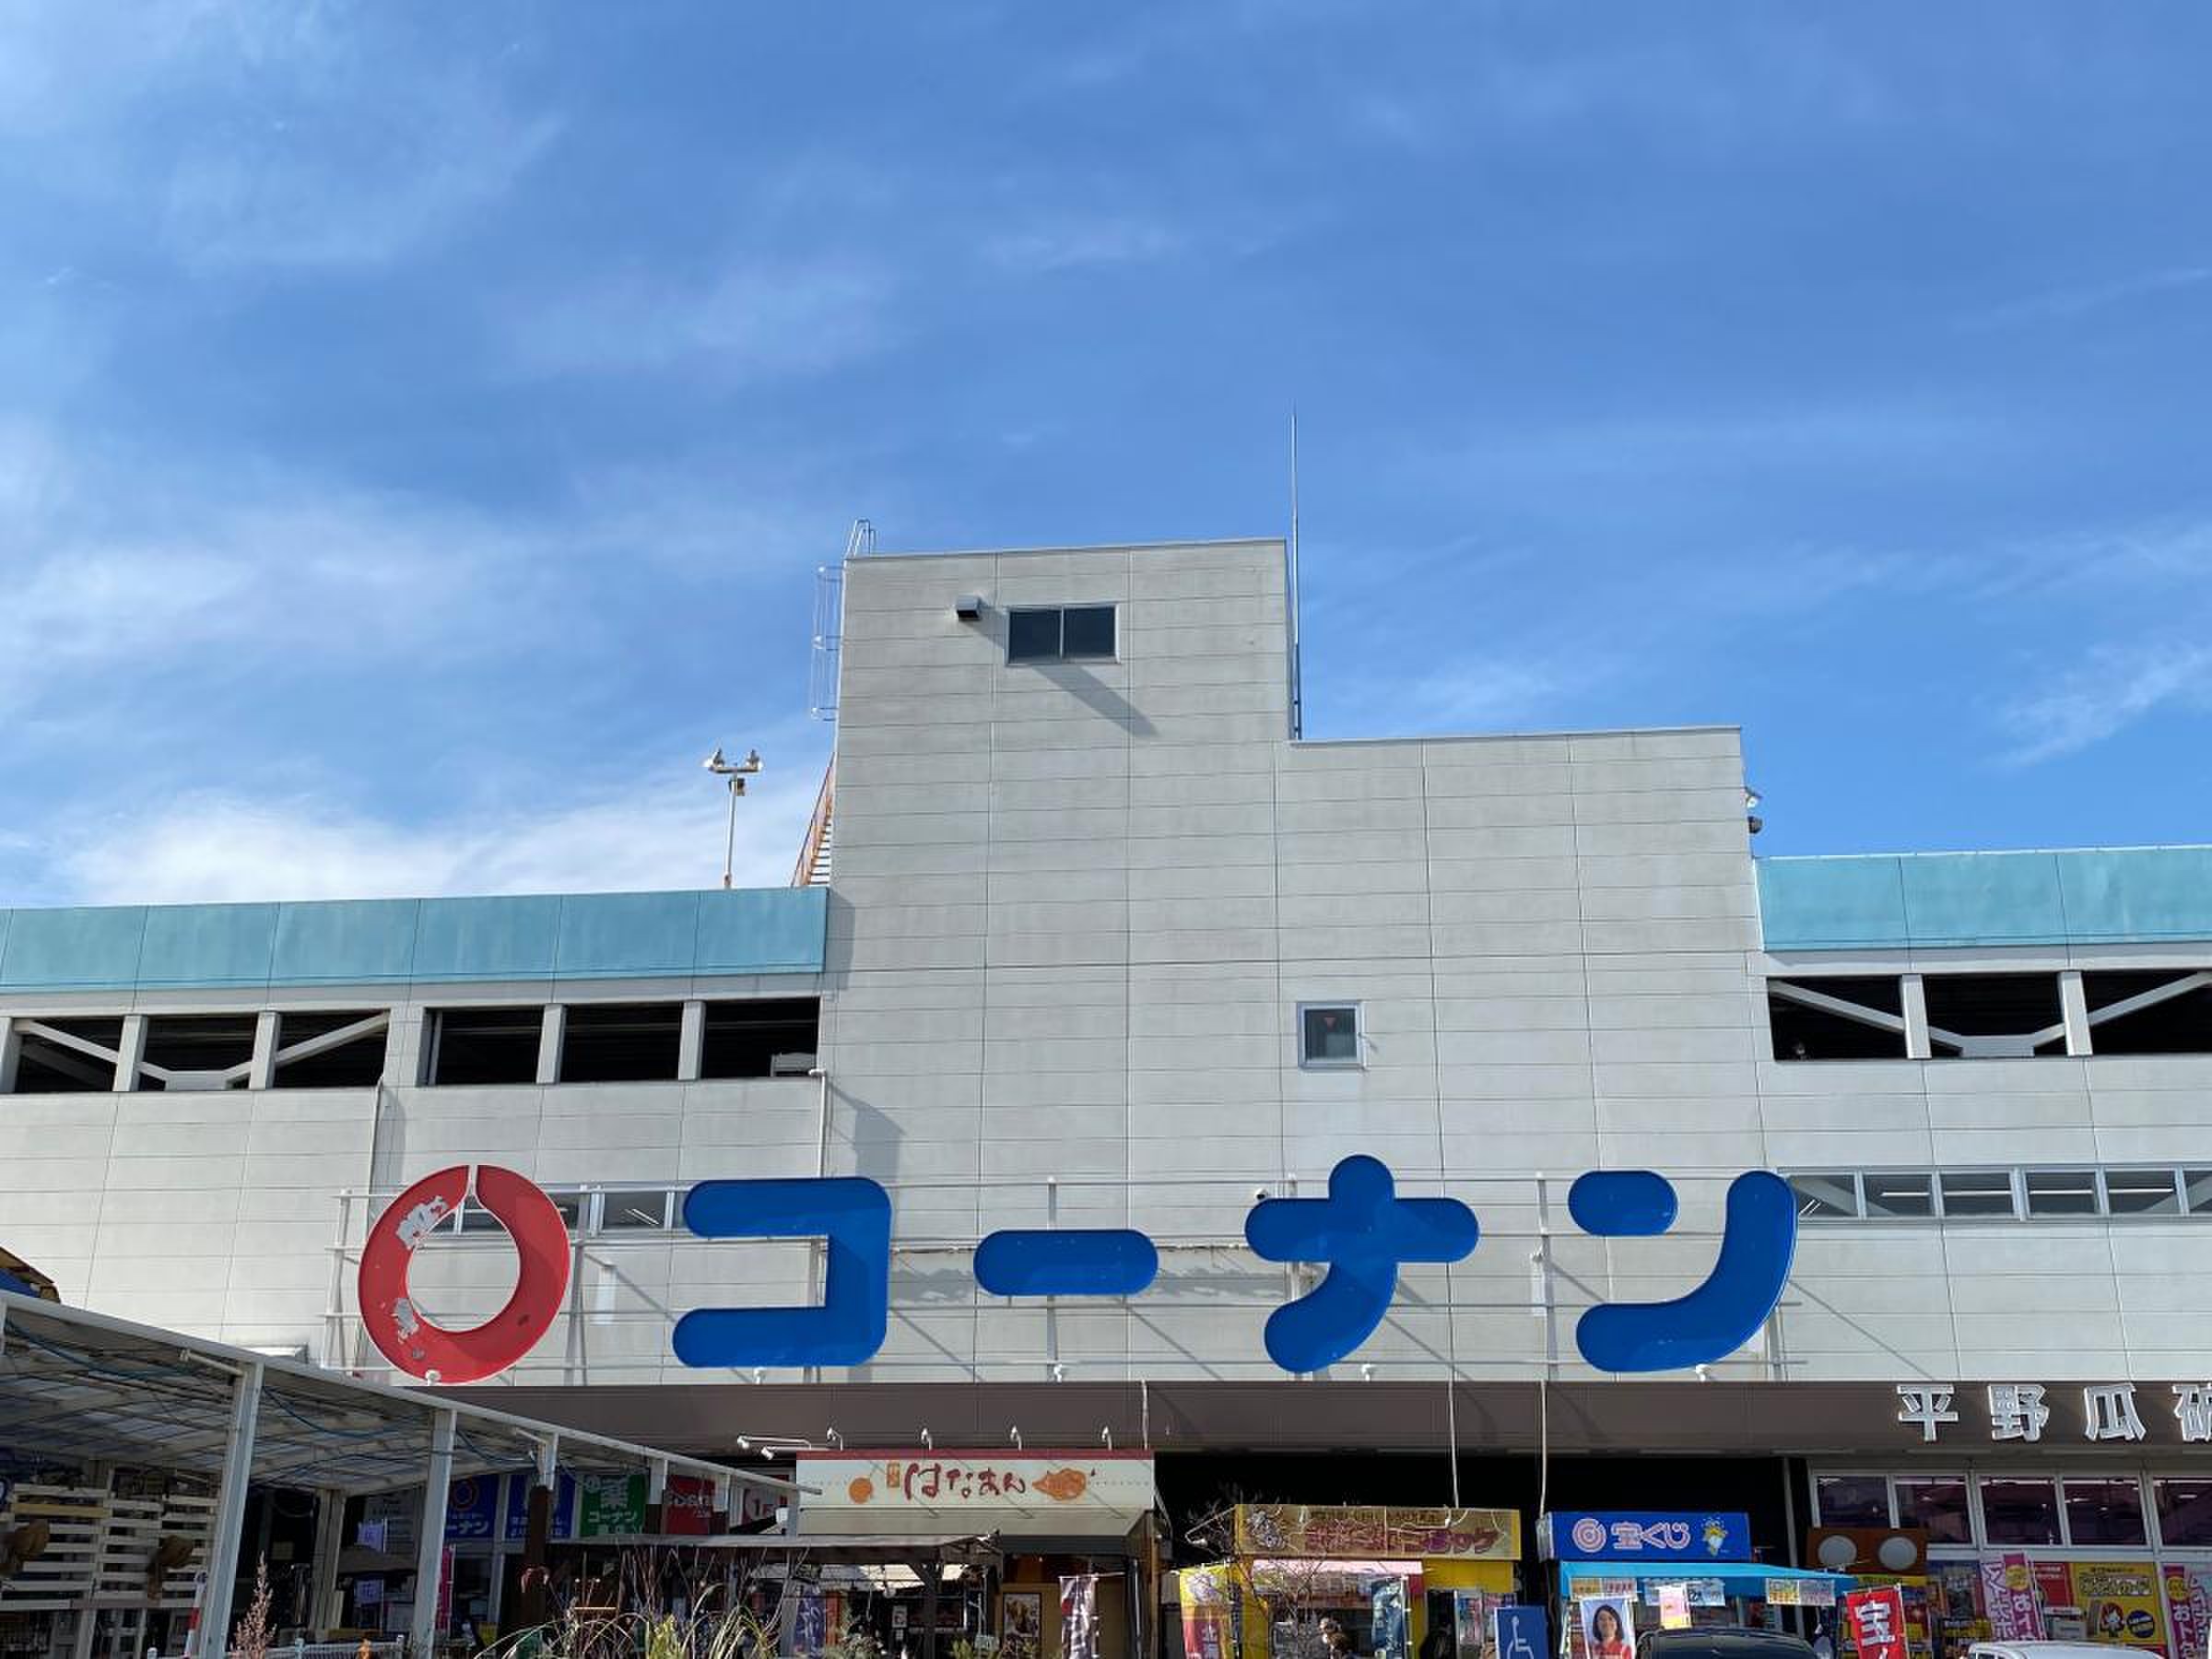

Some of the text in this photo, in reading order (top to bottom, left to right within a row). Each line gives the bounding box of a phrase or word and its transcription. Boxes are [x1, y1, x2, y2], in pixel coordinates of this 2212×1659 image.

[672, 1155, 1798, 1372] コーナン
[1611, 1522, 1690, 1550] 宝くじ
